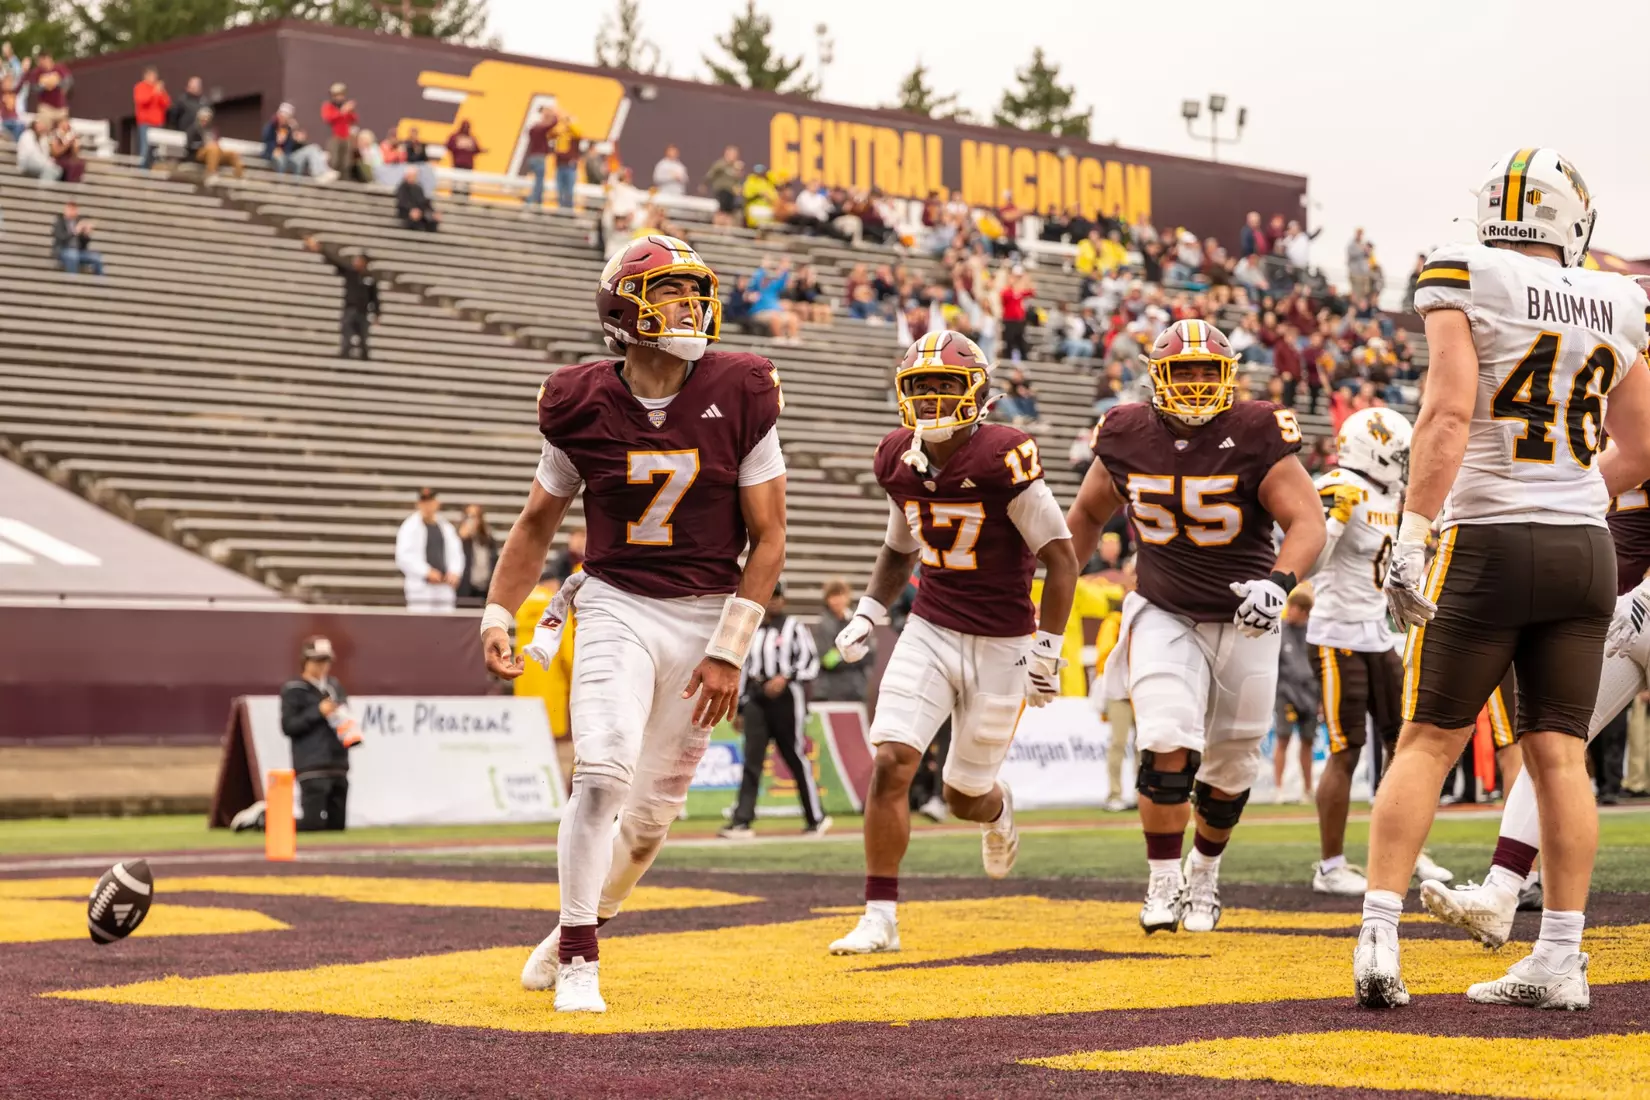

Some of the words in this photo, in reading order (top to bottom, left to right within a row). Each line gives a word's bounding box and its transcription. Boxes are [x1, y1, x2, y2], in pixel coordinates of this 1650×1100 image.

[770, 112, 949, 204] CENTRAL
[960, 139, 1152, 226] MICHIGAN
[1488, 225, 1537, 239] Riddell
[1527, 286, 1613, 335] BAUMAN
[1490, 331, 1617, 469] 46
[1004, 438, 1042, 485] 17
[626, 447, 700, 546] 7
[1126, 473, 1243, 547] 55
[904, 500, 986, 571] 17
[360, 703, 403, 736] Mt.
[412, 702, 512, 736] Pleasant
[1007, 737, 1067, 768] chigan
